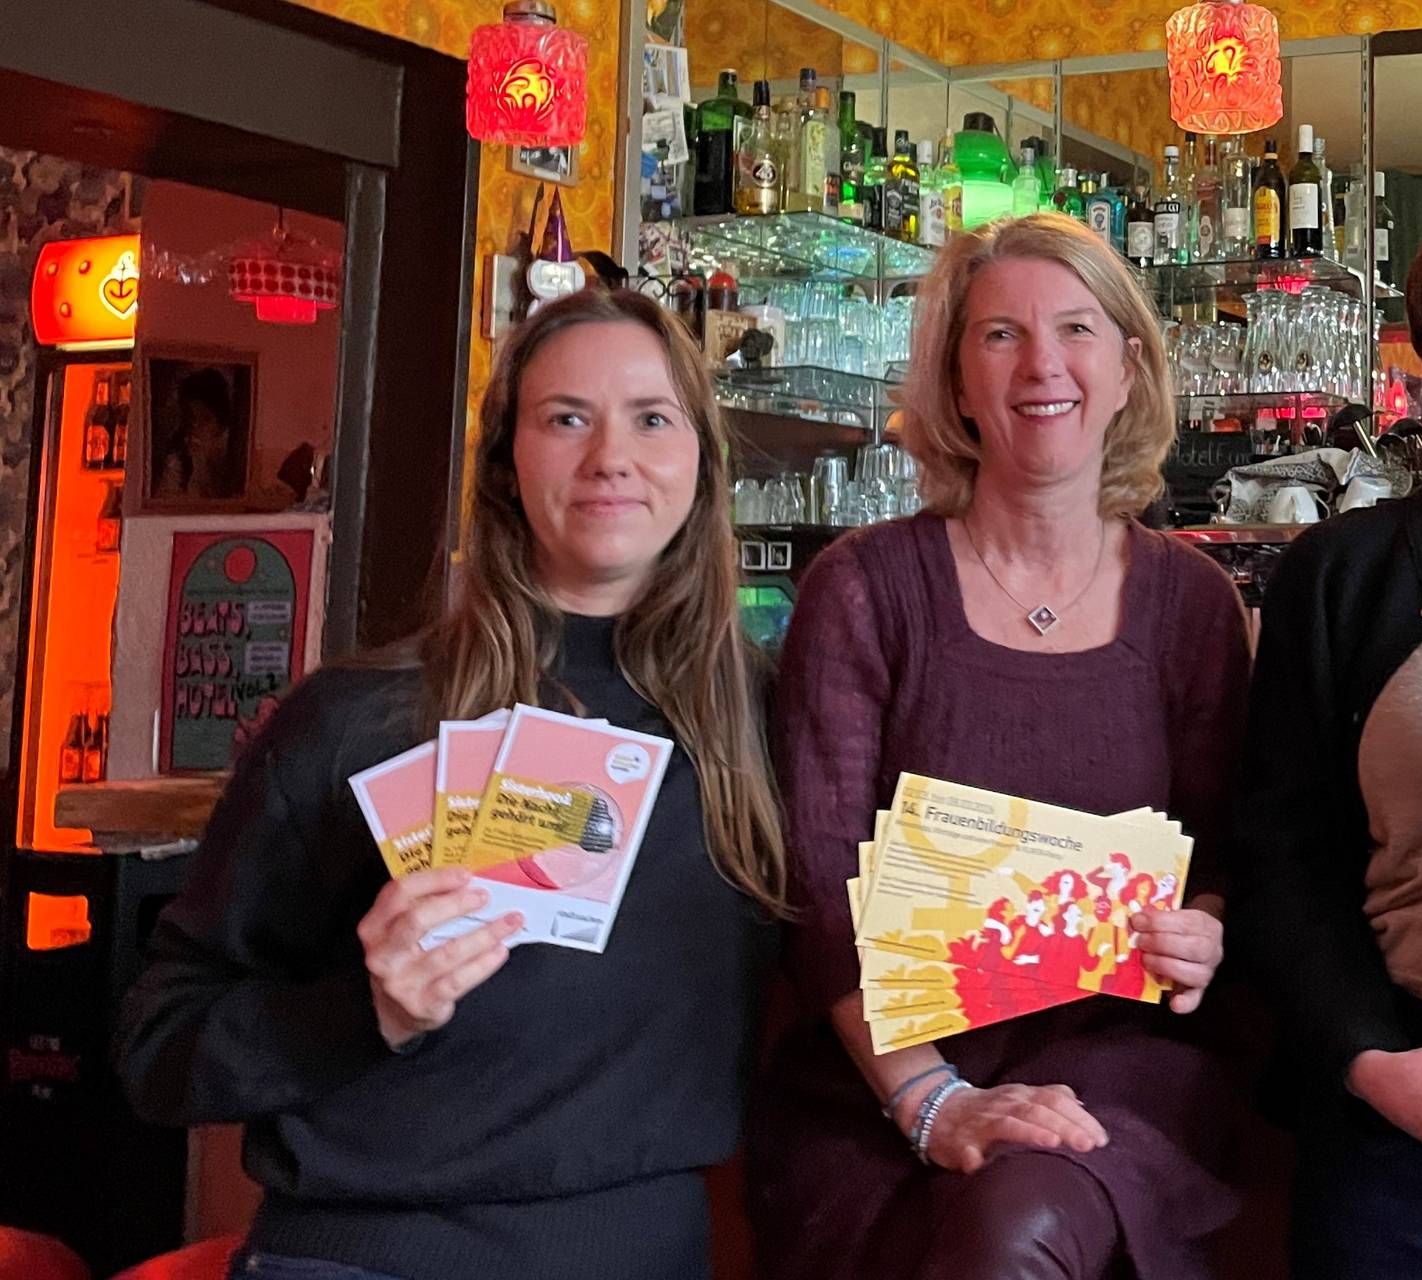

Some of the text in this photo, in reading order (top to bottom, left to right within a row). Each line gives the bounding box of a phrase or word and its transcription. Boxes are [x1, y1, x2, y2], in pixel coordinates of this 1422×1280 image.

[496, 792, 561, 818] Die Nacht
[924, 805, 1083, 851] Frauenbildungswoche
